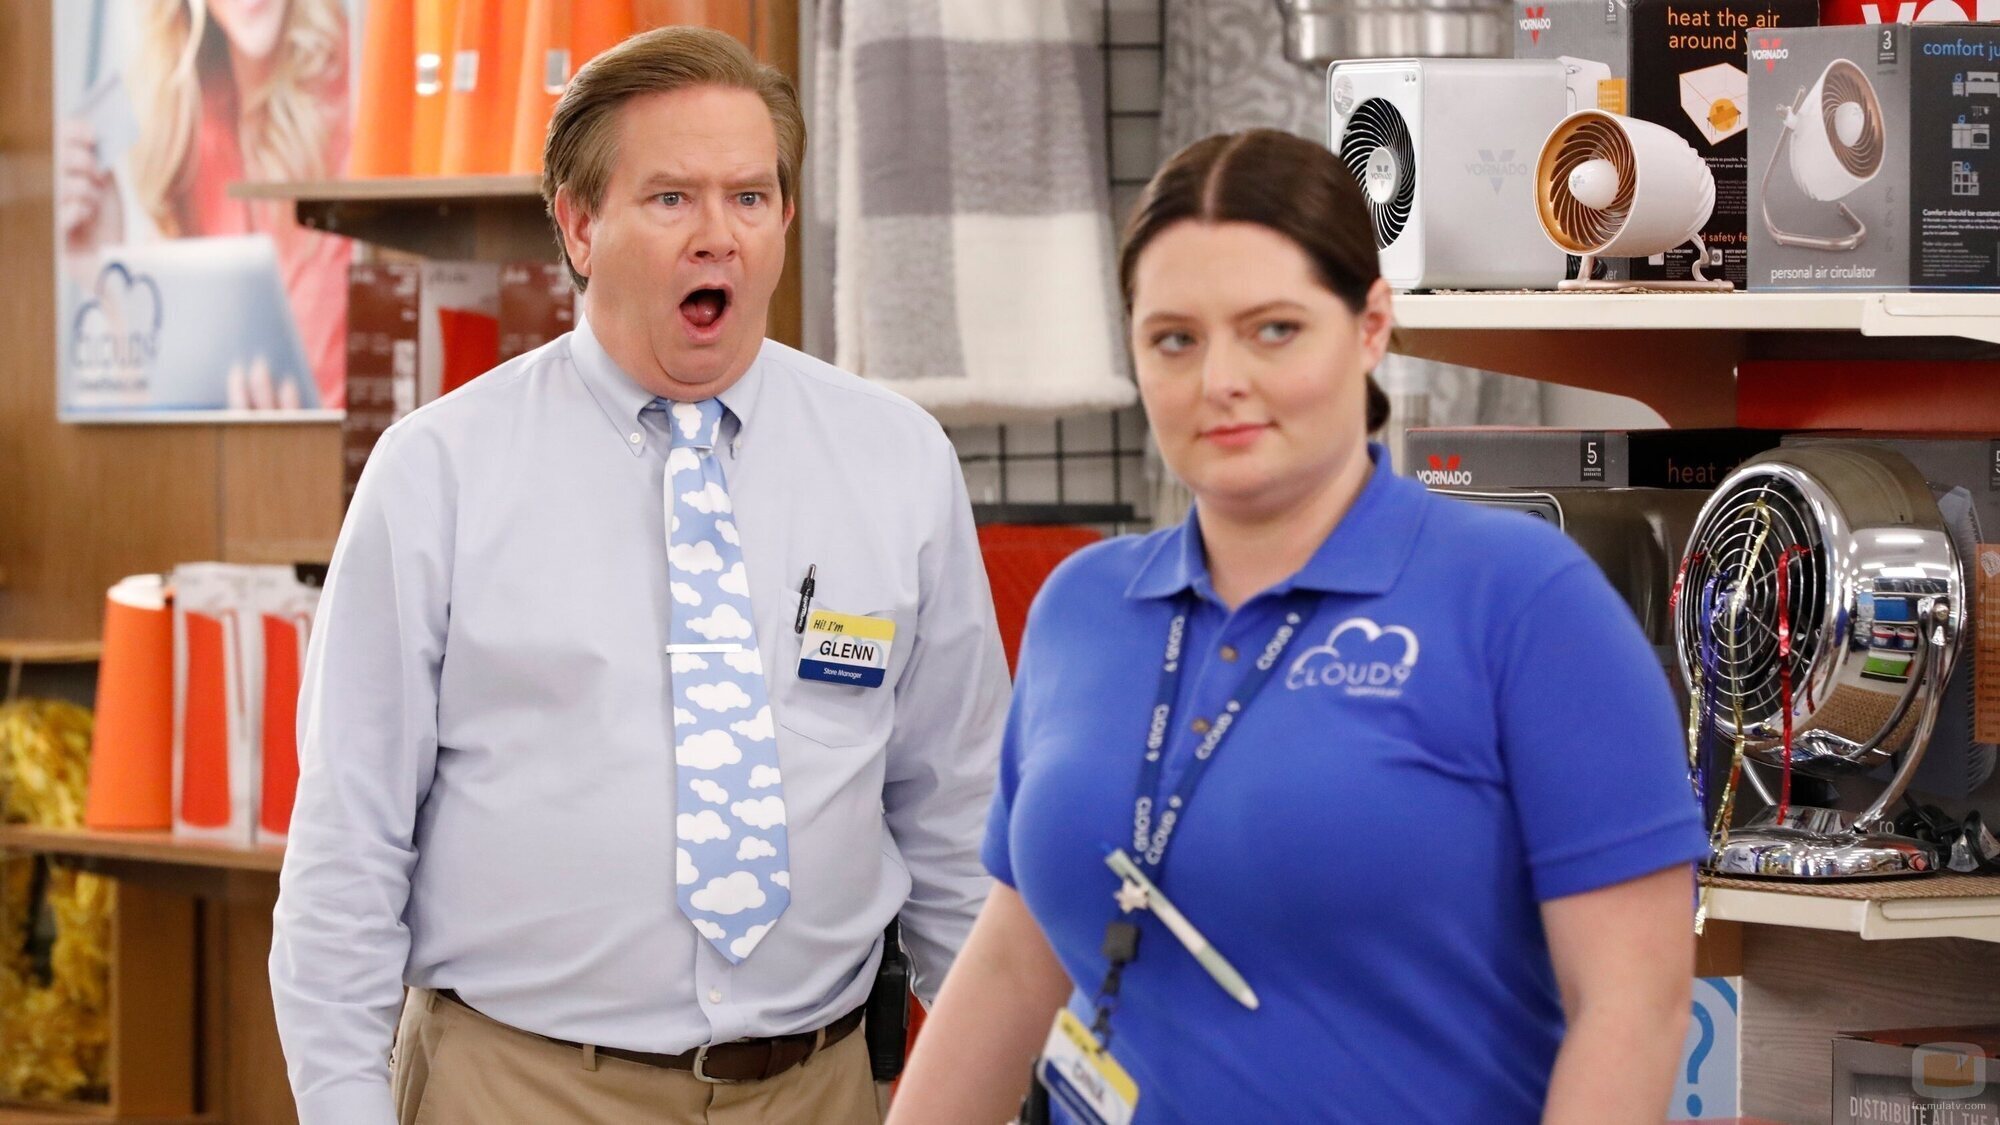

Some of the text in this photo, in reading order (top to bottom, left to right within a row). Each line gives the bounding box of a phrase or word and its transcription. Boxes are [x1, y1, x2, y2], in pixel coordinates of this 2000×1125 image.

[1519, 18, 1551, 30] VORNADO
[1668, 6, 1780, 28] heat the air
[1669, 31, 1736, 49] around
[1883, 30, 1892, 50] 3
[1924, 39, 1984, 57] comfort
[1751, 48, 1788, 60] VORNADO
[1465, 163, 1527, 176] VORNADO
[1709, 232, 1736, 244] safety
[1770, 265, 1877, 283] personal air circulator
[1587, 442, 1597, 465] 5
[1416, 470, 1472, 486] VORNADO
[1668, 458, 1716, 483] heat
[813, 619, 844, 632] Hi! I'm
[819, 640, 874, 661] GLENN
[1256, 624, 1294, 671] CLOUD
[823, 667, 862, 679] Store Manager
[1195, 712, 1233, 760] CLOUD
[1133, 796, 1152, 852] CLOUD
[1145, 809, 1177, 866] CLOUD
[1850, 1096, 1927, 1125] DISTRIBUTE
